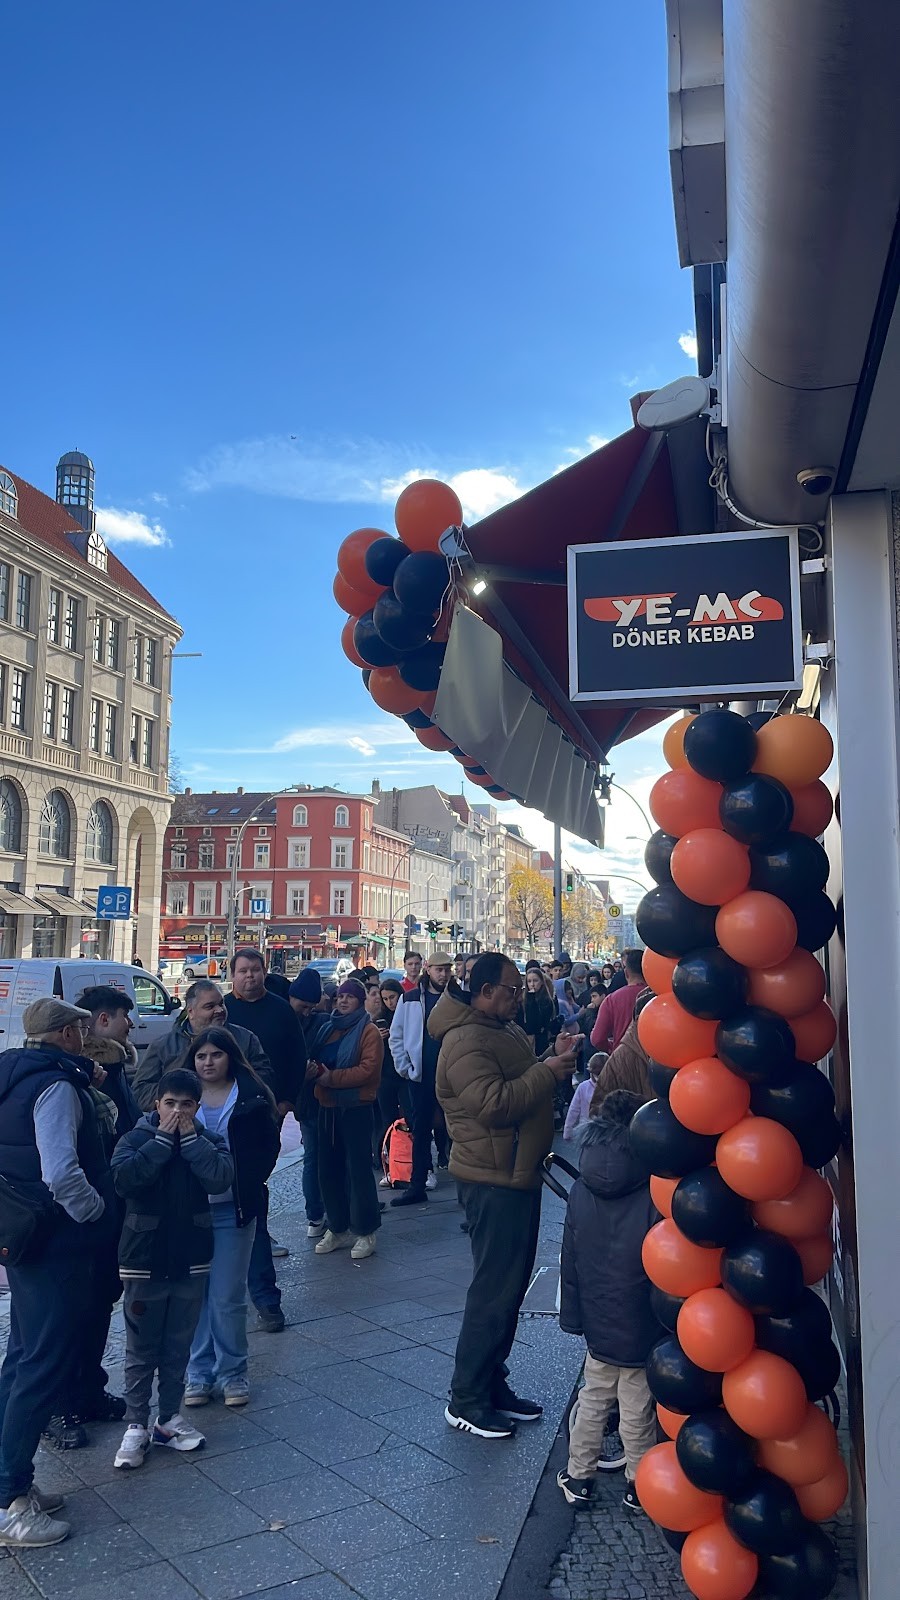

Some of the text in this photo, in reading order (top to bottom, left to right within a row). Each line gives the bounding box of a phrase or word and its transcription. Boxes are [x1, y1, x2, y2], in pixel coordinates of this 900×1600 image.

[612, 590, 763, 626] YE-MC
[612, 625, 755, 648] DÖNER KEBAB
[116, 894, 127, 911] P
[254, 901, 263, 912] U
[9, 1521, 31, 1541] N
